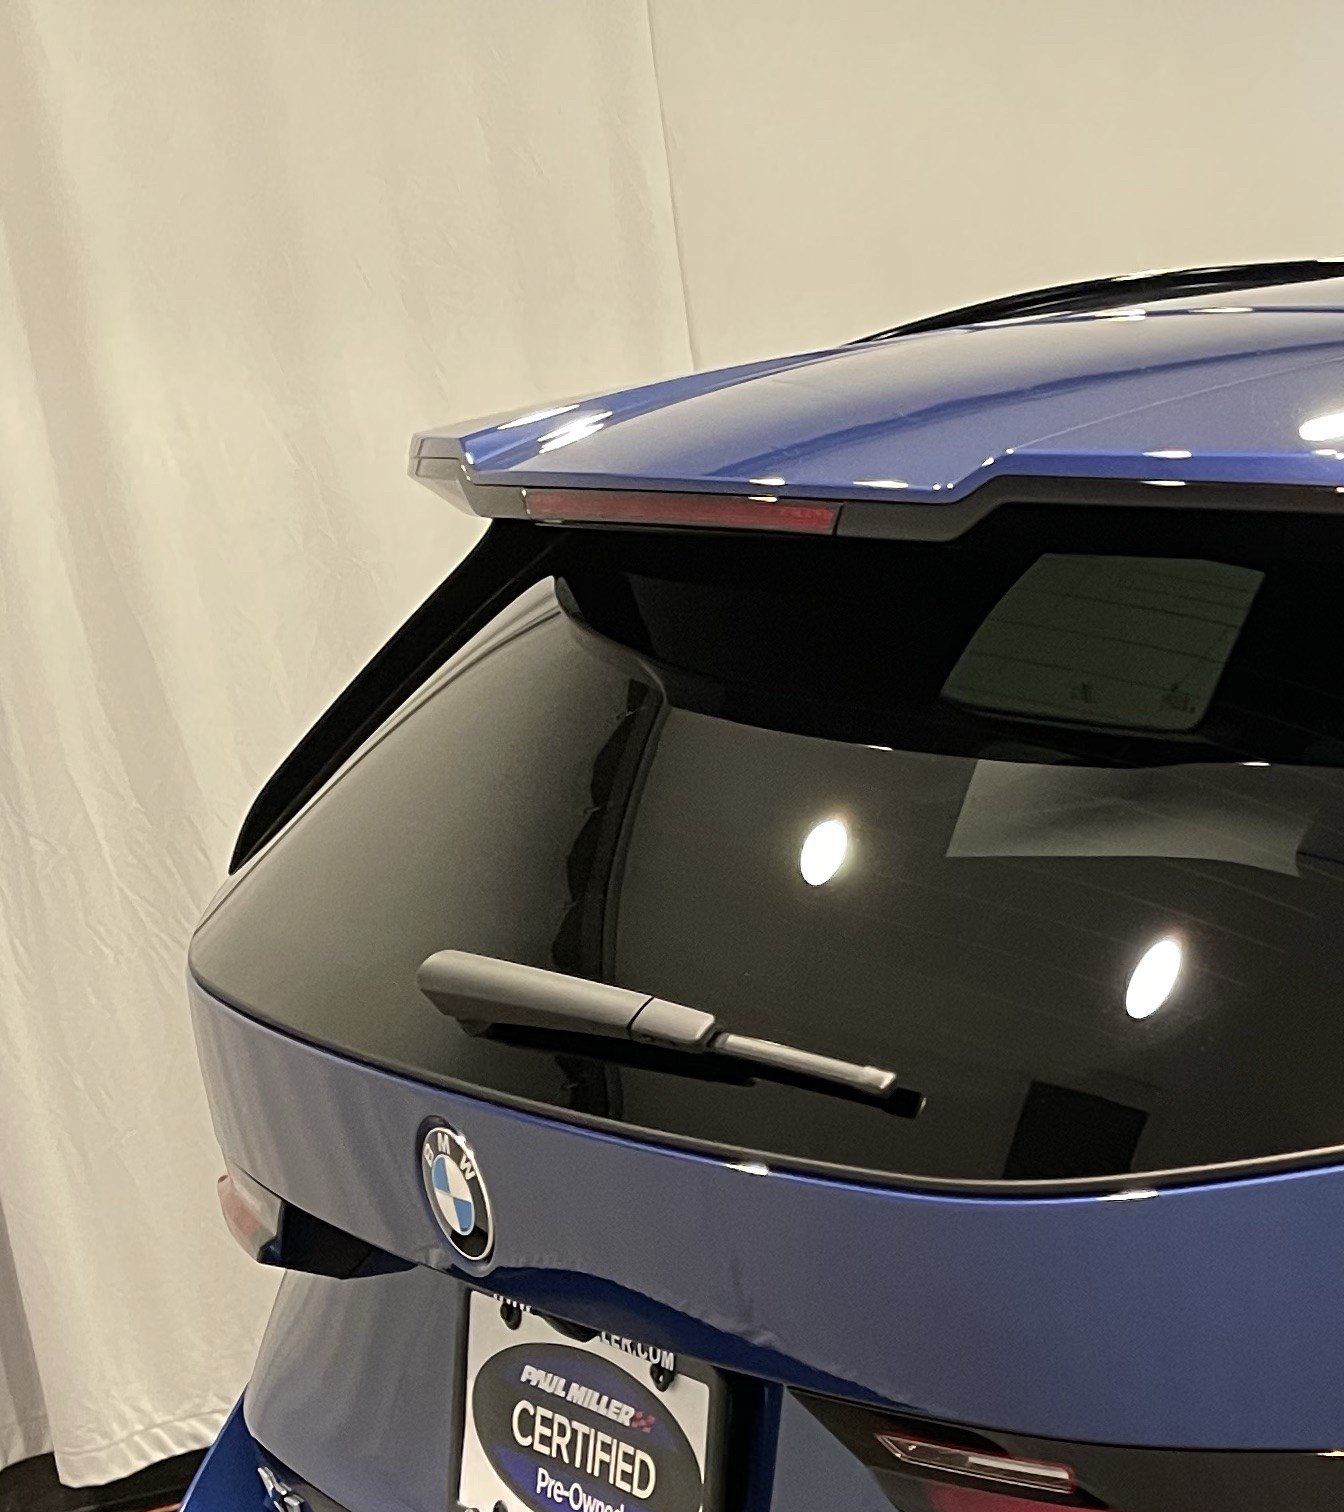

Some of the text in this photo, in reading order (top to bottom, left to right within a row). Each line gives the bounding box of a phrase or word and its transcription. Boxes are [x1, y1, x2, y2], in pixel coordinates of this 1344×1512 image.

[424, 1132, 476, 1180] BMW
[520, 1364, 635, 1427] PAUL MILLER
[512, 1399, 656, 1499] CERTIFIED
